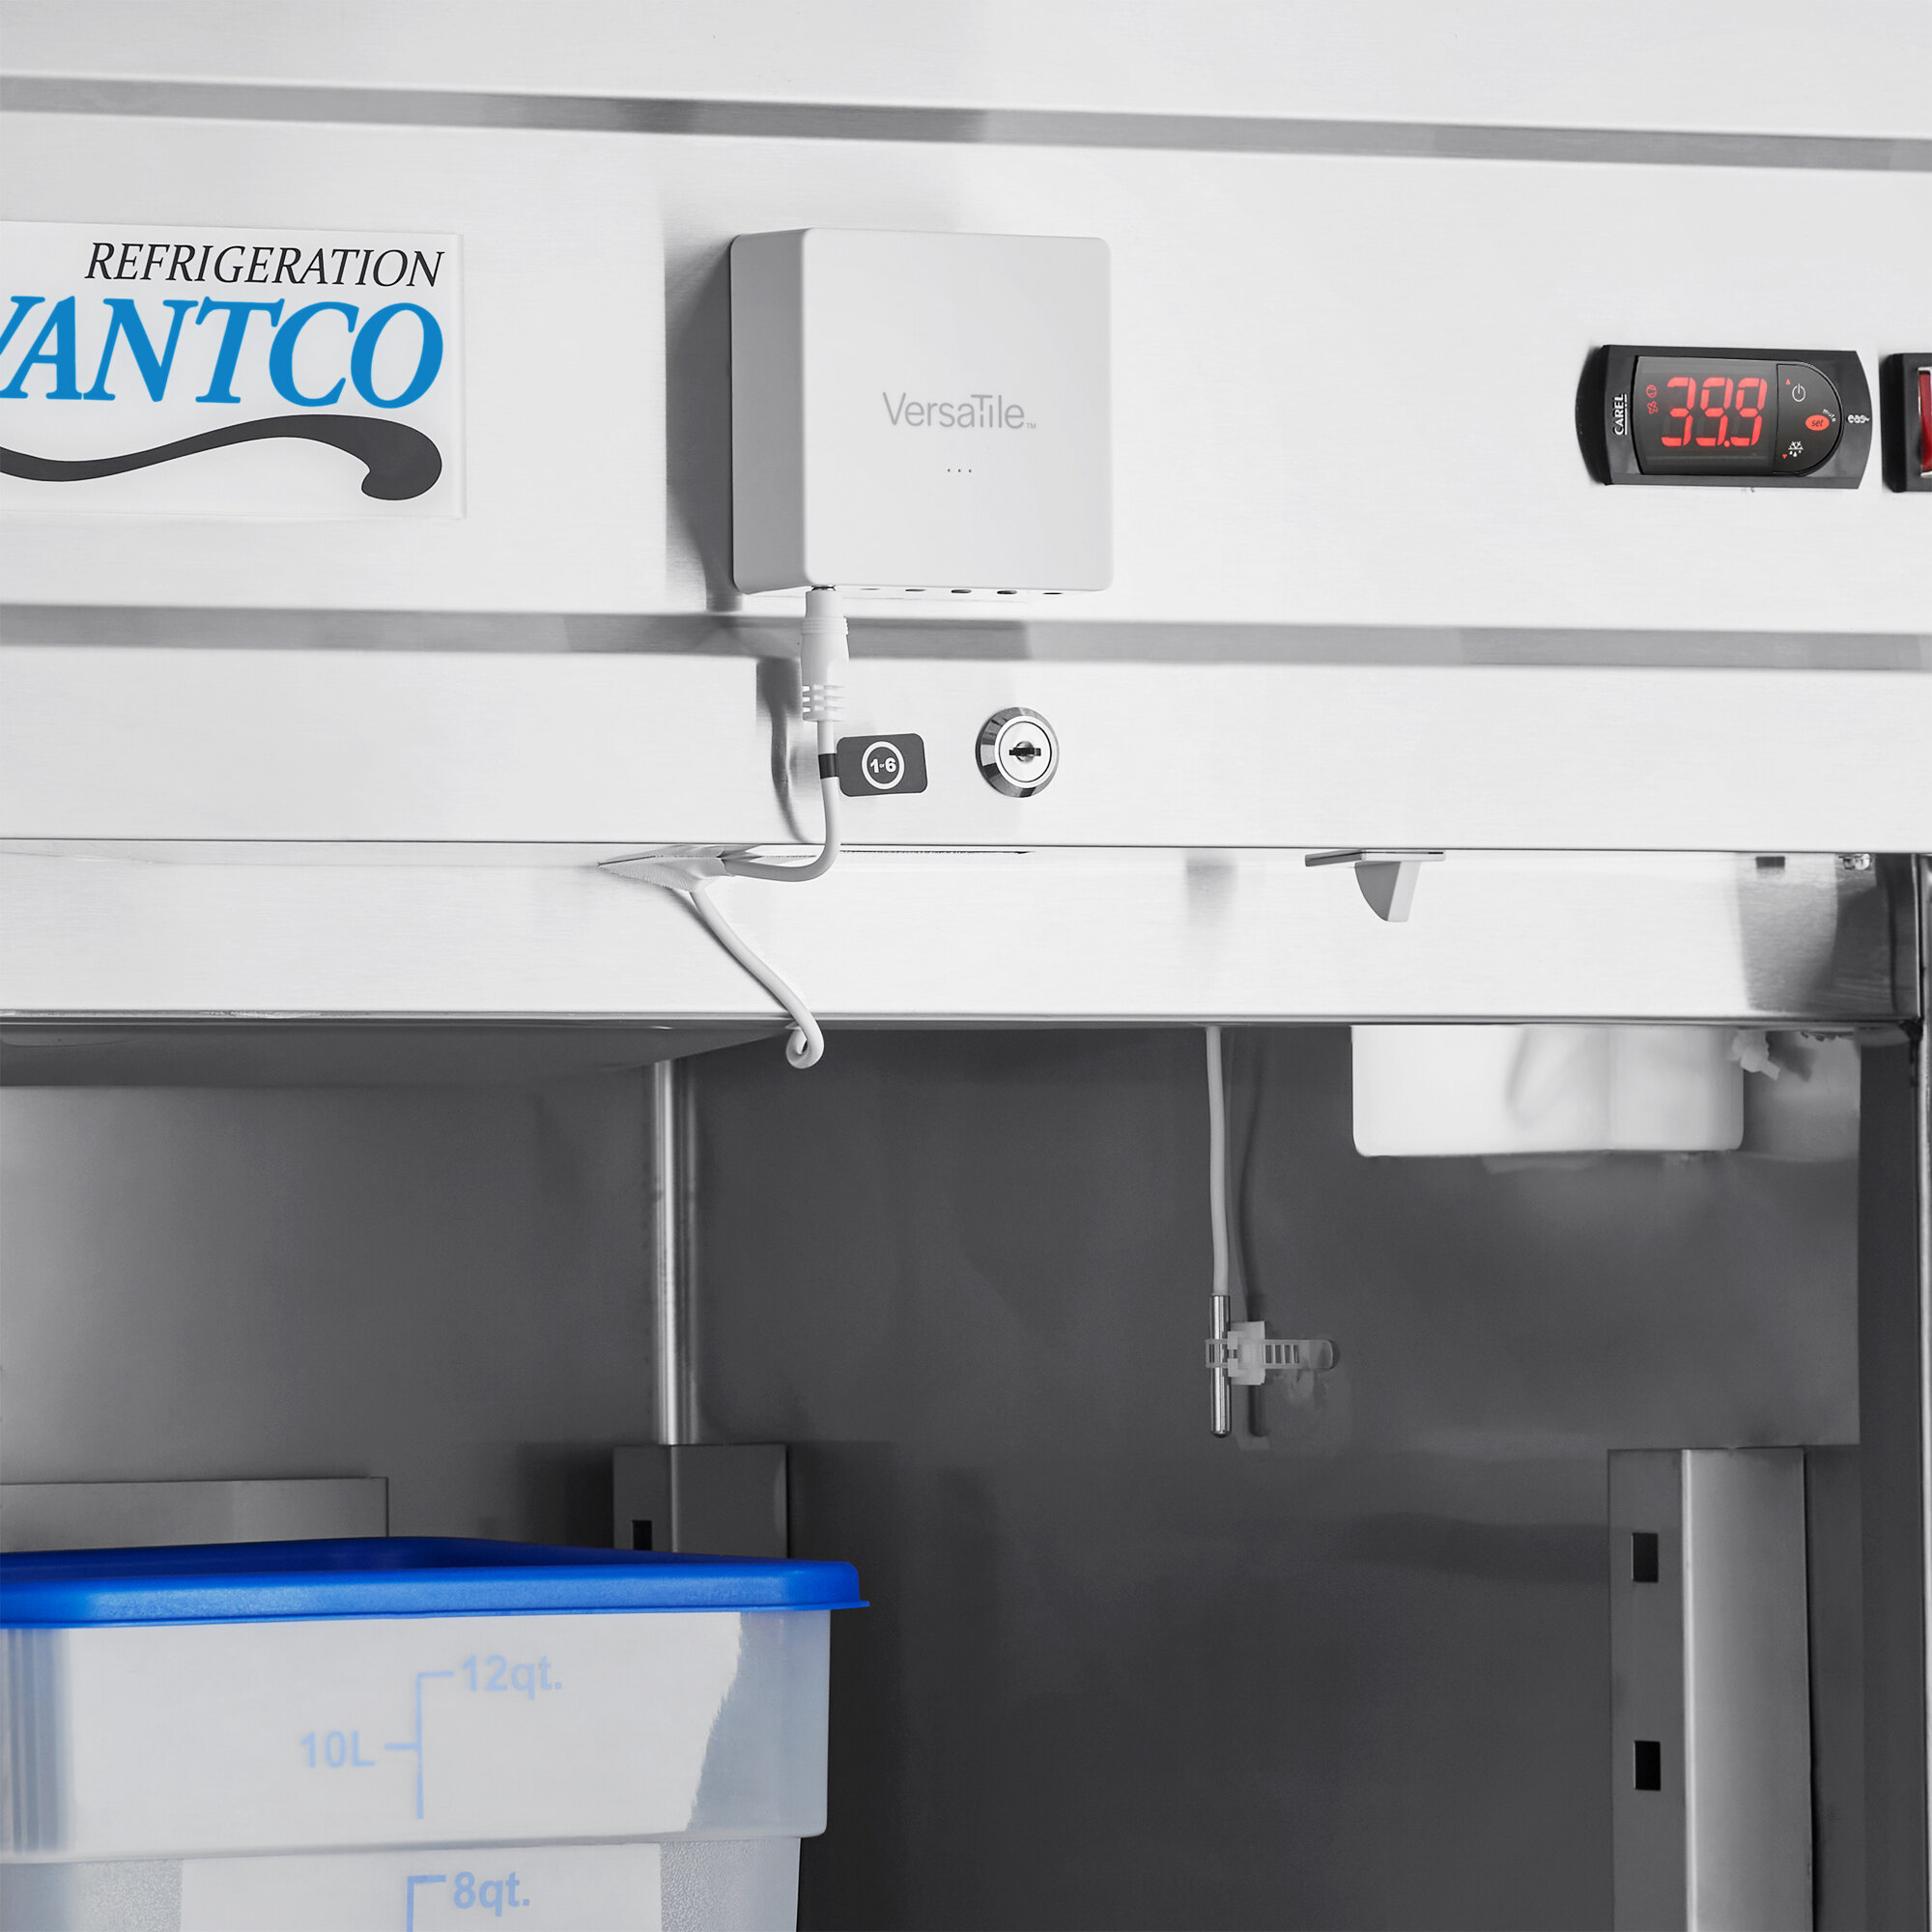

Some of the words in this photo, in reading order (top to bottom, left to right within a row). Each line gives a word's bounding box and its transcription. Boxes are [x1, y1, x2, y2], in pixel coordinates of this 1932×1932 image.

[84, 242, 445, 288] REFRIGERATION
[1613, 393, 1625, 436] CAREL
[1662, 377, 1768, 448] 39.9
[461, 1654, 562, 1700] 12qt.
[300, 1730, 377, 1769] 10L
[453, 1871, 530, 1918] 8qt.
